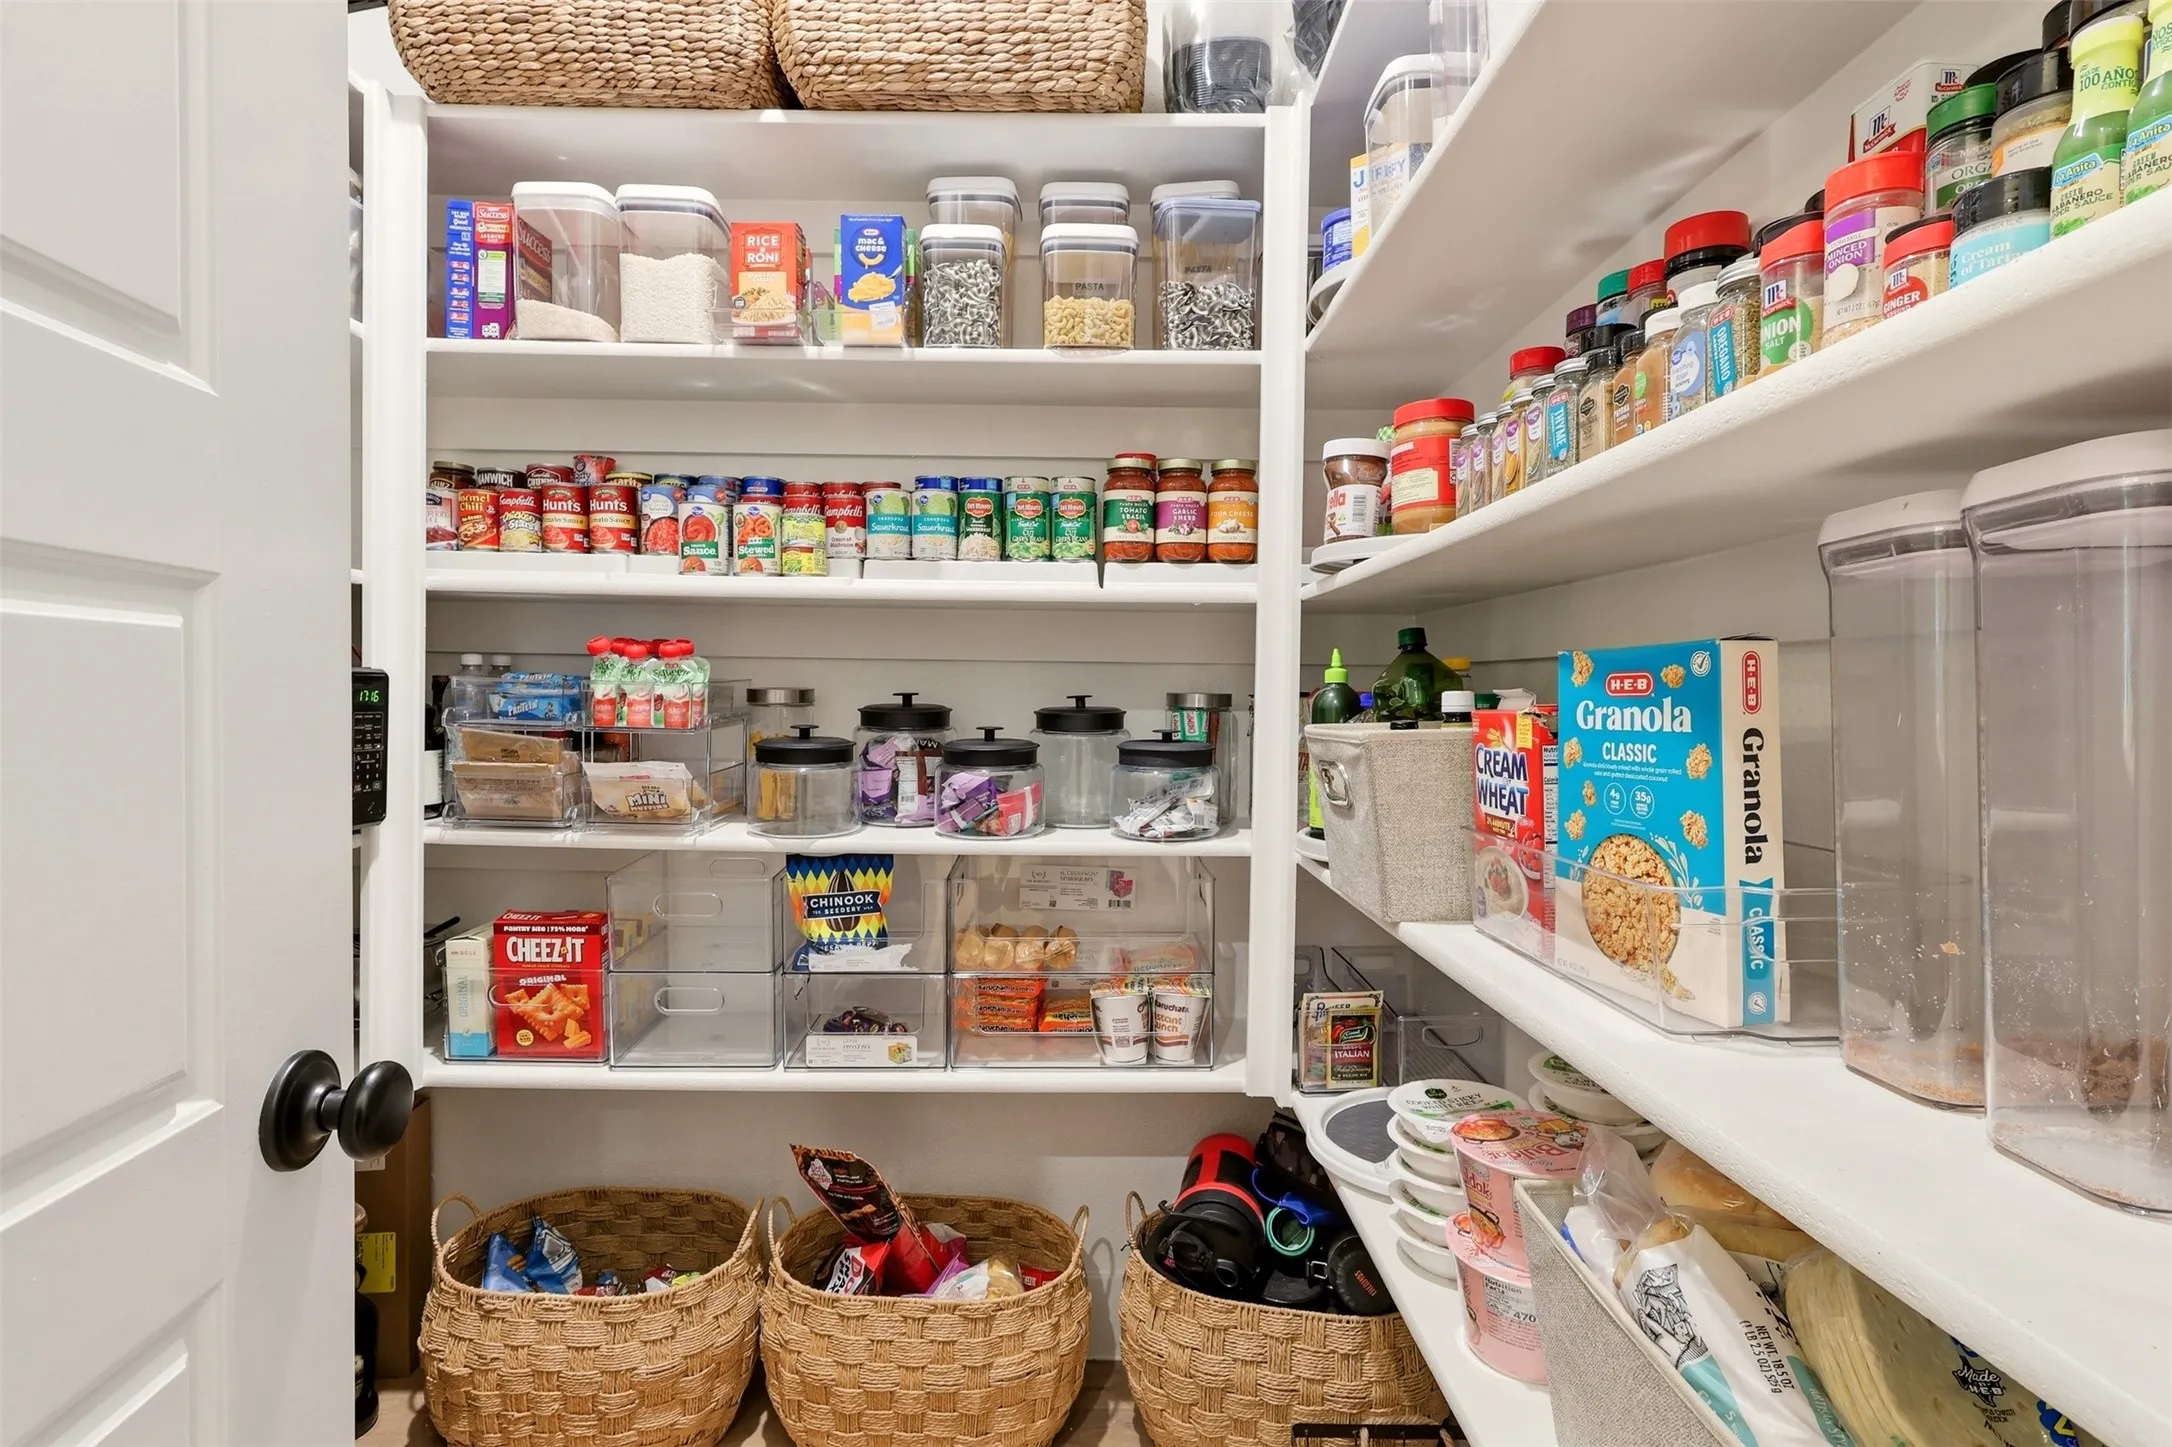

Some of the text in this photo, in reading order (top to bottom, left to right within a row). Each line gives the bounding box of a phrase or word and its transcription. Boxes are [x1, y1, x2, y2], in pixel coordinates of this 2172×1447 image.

[2080, 72, 2100, 92] 100
[2066, 160, 2096, 178] Anita
[2146, 163, 2172, 176] SAU
[747, 236, 779, 246] RICE
[747, 253, 779, 263] RONI
[1826, 241, 1867, 262] MINCED
[1961, 241, 2011, 263] Cream
[1828, 250, 1863, 268] ONION
[1185, 265, 1213, 274] PASTA
[1961, 263, 1972, 277] of
[1075, 282, 1104, 291] PASTA
[1883, 290, 1921, 314] GINGER
[1766, 336, 1785, 350] SALT
[1717, 326, 1731, 380] OREGANO
[1555, 407, 1567, 448] THYME
[460, 502, 483, 511] Chili
[500, 494, 535, 506] Campbell's
[543, 498, 581, 512] Hunt's
[590, 498, 628, 512] Hunt's
[1329, 491, 1346, 509] ella
[825, 505, 863, 518] Campbell's
[871, 522, 909, 532] Sauerkraut
[917, 523, 955, 533] Sauerkraut
[683, 546, 717, 556] Sauce
[738, 545, 775, 556] Stewed
[1610, 680, 1648, 691] H-E-B
[1746, 660, 1757, 707] H-E-B
[508, 700, 538, 717] PROTEIN
[1576, 698, 1692, 733] Granola
[1602, 742, 1657, 763] CLASSIC
[1476, 743, 1528, 781] CREAM
[627, 792, 666, 807] MiNi
[1477, 777, 1529, 816] WHEAT
[1610, 788, 1651, 804] 4g 35g
[1742, 728, 1768, 865] Granola
[810, 894, 874, 908] CHINOOK
[824, 906, 861, 915] SEEDERY
[1749, 907, 1765, 970] CLASSIC
[519, 975, 567, 986] ORIGINAL
[458, 976, 467, 1018] ORIGINAL
[1155, 1000, 1190, 1013] aruchan
[1155, 1015, 1182, 1025] stant
[1155, 1023, 1178, 1032] unch
[1334, 1050, 1370, 1058] ITALIAN
[1406, 1092, 1481, 1108] COOKED STICKY
[1421, 1100, 1477, 1111] WHITE RICE
[1485, 1277, 1523, 1295] Nutrition
[1513, 1311, 1537, 1323] 470
[1745, 1329, 1759, 1342] LB
[1750, 1343, 1764, 1358] 2.5
[1755, 1325, 1768, 1341] NET
[1772, 1358, 1788, 1378] 18.5
[1781, 1377, 1795, 1389] OZ
[1958, 1365, 2000, 1383] Made
[1725, 1411, 1736, 1420] 5
